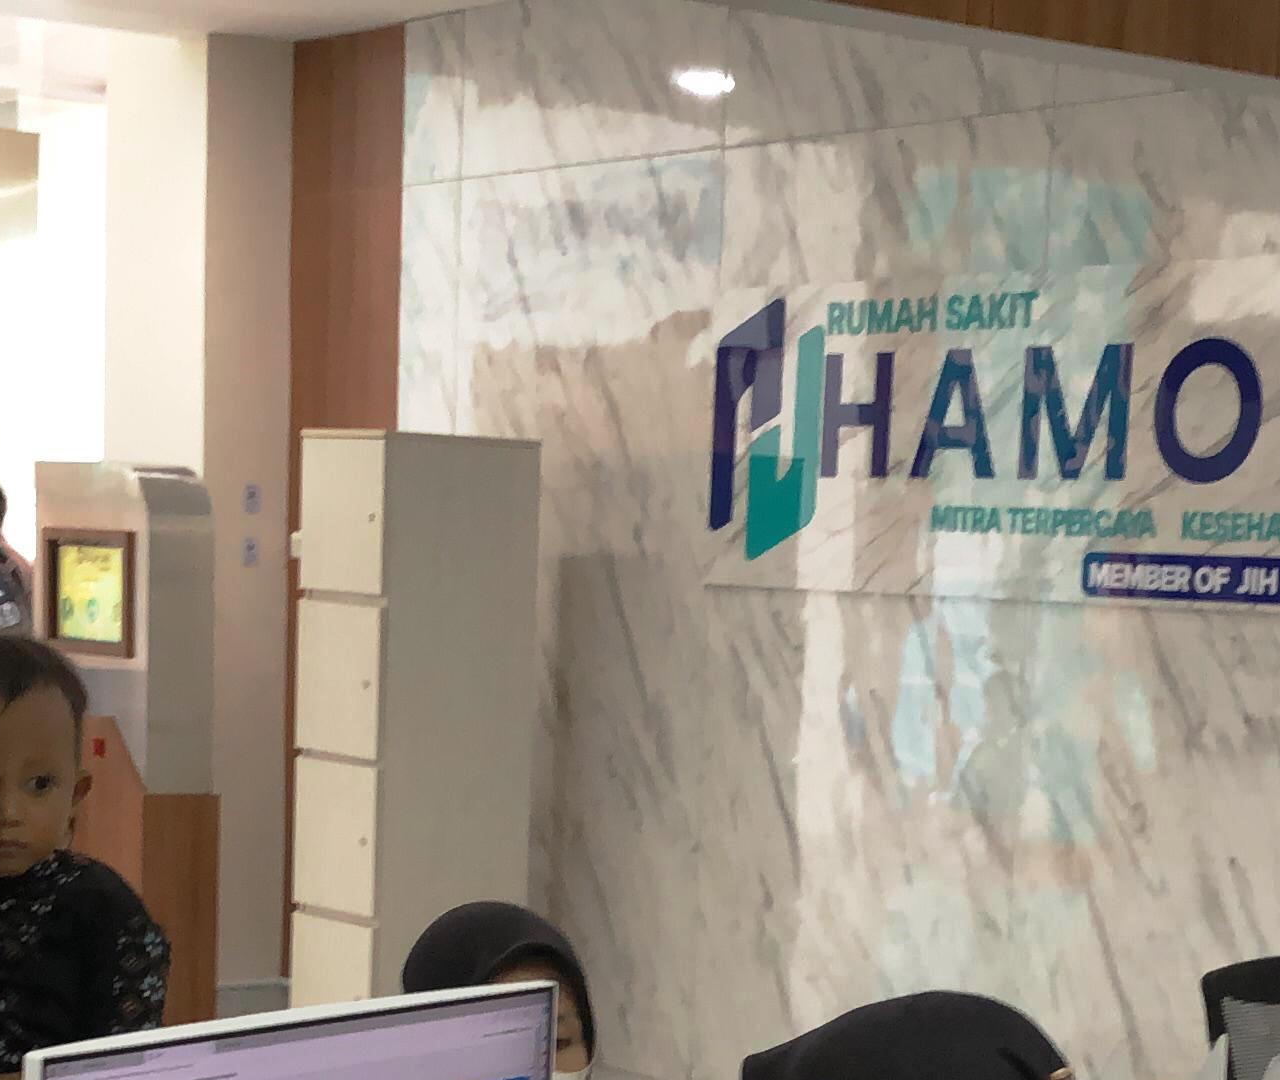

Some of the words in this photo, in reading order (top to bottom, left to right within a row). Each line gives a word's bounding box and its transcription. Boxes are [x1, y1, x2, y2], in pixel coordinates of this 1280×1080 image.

[827, 294, 938, 335] RUMAH
[945, 290, 1040, 330] SAKIT
[930, 505, 1002, 534] MITRA
[1007, 508, 1156, 538] TERPERCAYA
[1088, 562, 1191, 592] MEMBER
[1195, 563, 1230, 592] OF
[1237, 563, 1279, 596] JIH
